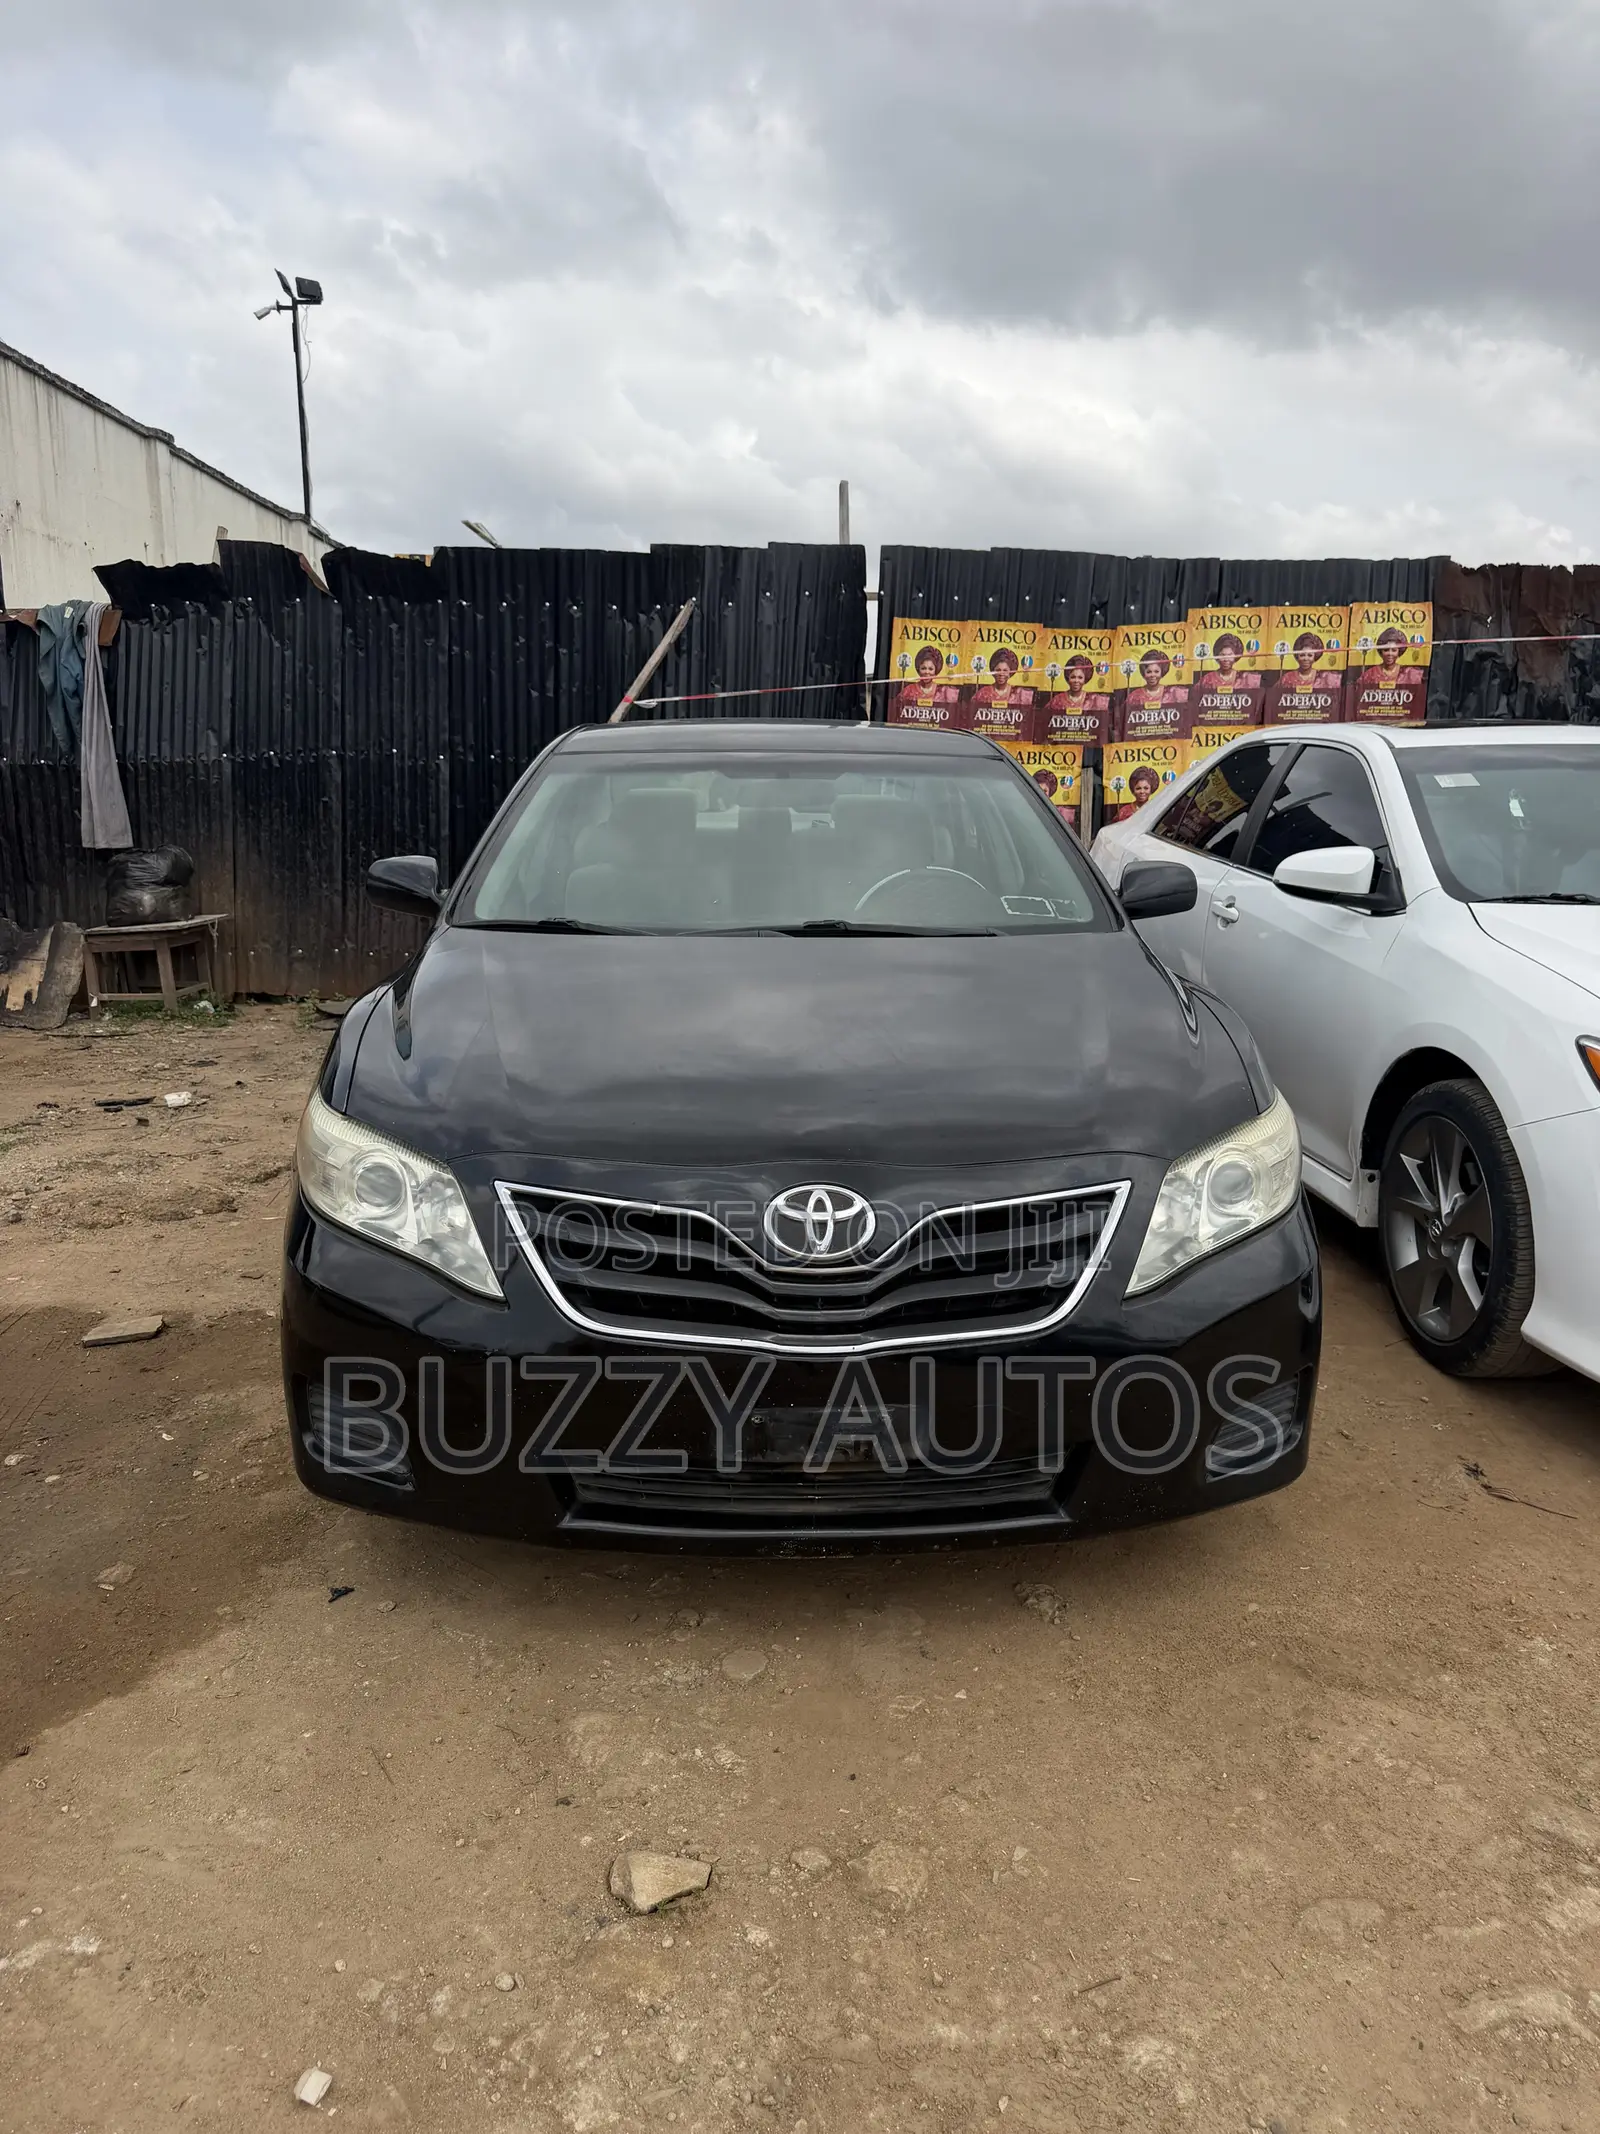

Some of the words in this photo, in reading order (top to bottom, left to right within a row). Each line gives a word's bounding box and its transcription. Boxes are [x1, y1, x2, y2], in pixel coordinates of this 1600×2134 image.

[1195, 614, 1262, 630] ABISCO
[1276, 613, 1343, 629] ABISCO
[1359, 608, 1427, 624] ABISCO
[899, 624, 961, 643] ABISCO
[973, 627, 1037, 645] ABISCO
[1121, 629, 1187, 647] ABISCO
[1048, 635, 1112, 651] ABISCO
[1198, 695, 1252, 710] ADEBAJO
[1277, 695, 1332, 710] ADEBAJO
[1359, 690, 1414, 705] ADEBAJO
[900, 707, 950, 723] ADEBAJO
[974, 709, 1024, 725] ADEBAJO
[1127, 709, 1180, 724] ADEBAJO
[1047, 717, 1100, 731] ADEBAJO
[1015, 750, 1077, 766] ABISCO
[1110, 745, 1177, 764] ABISCO
